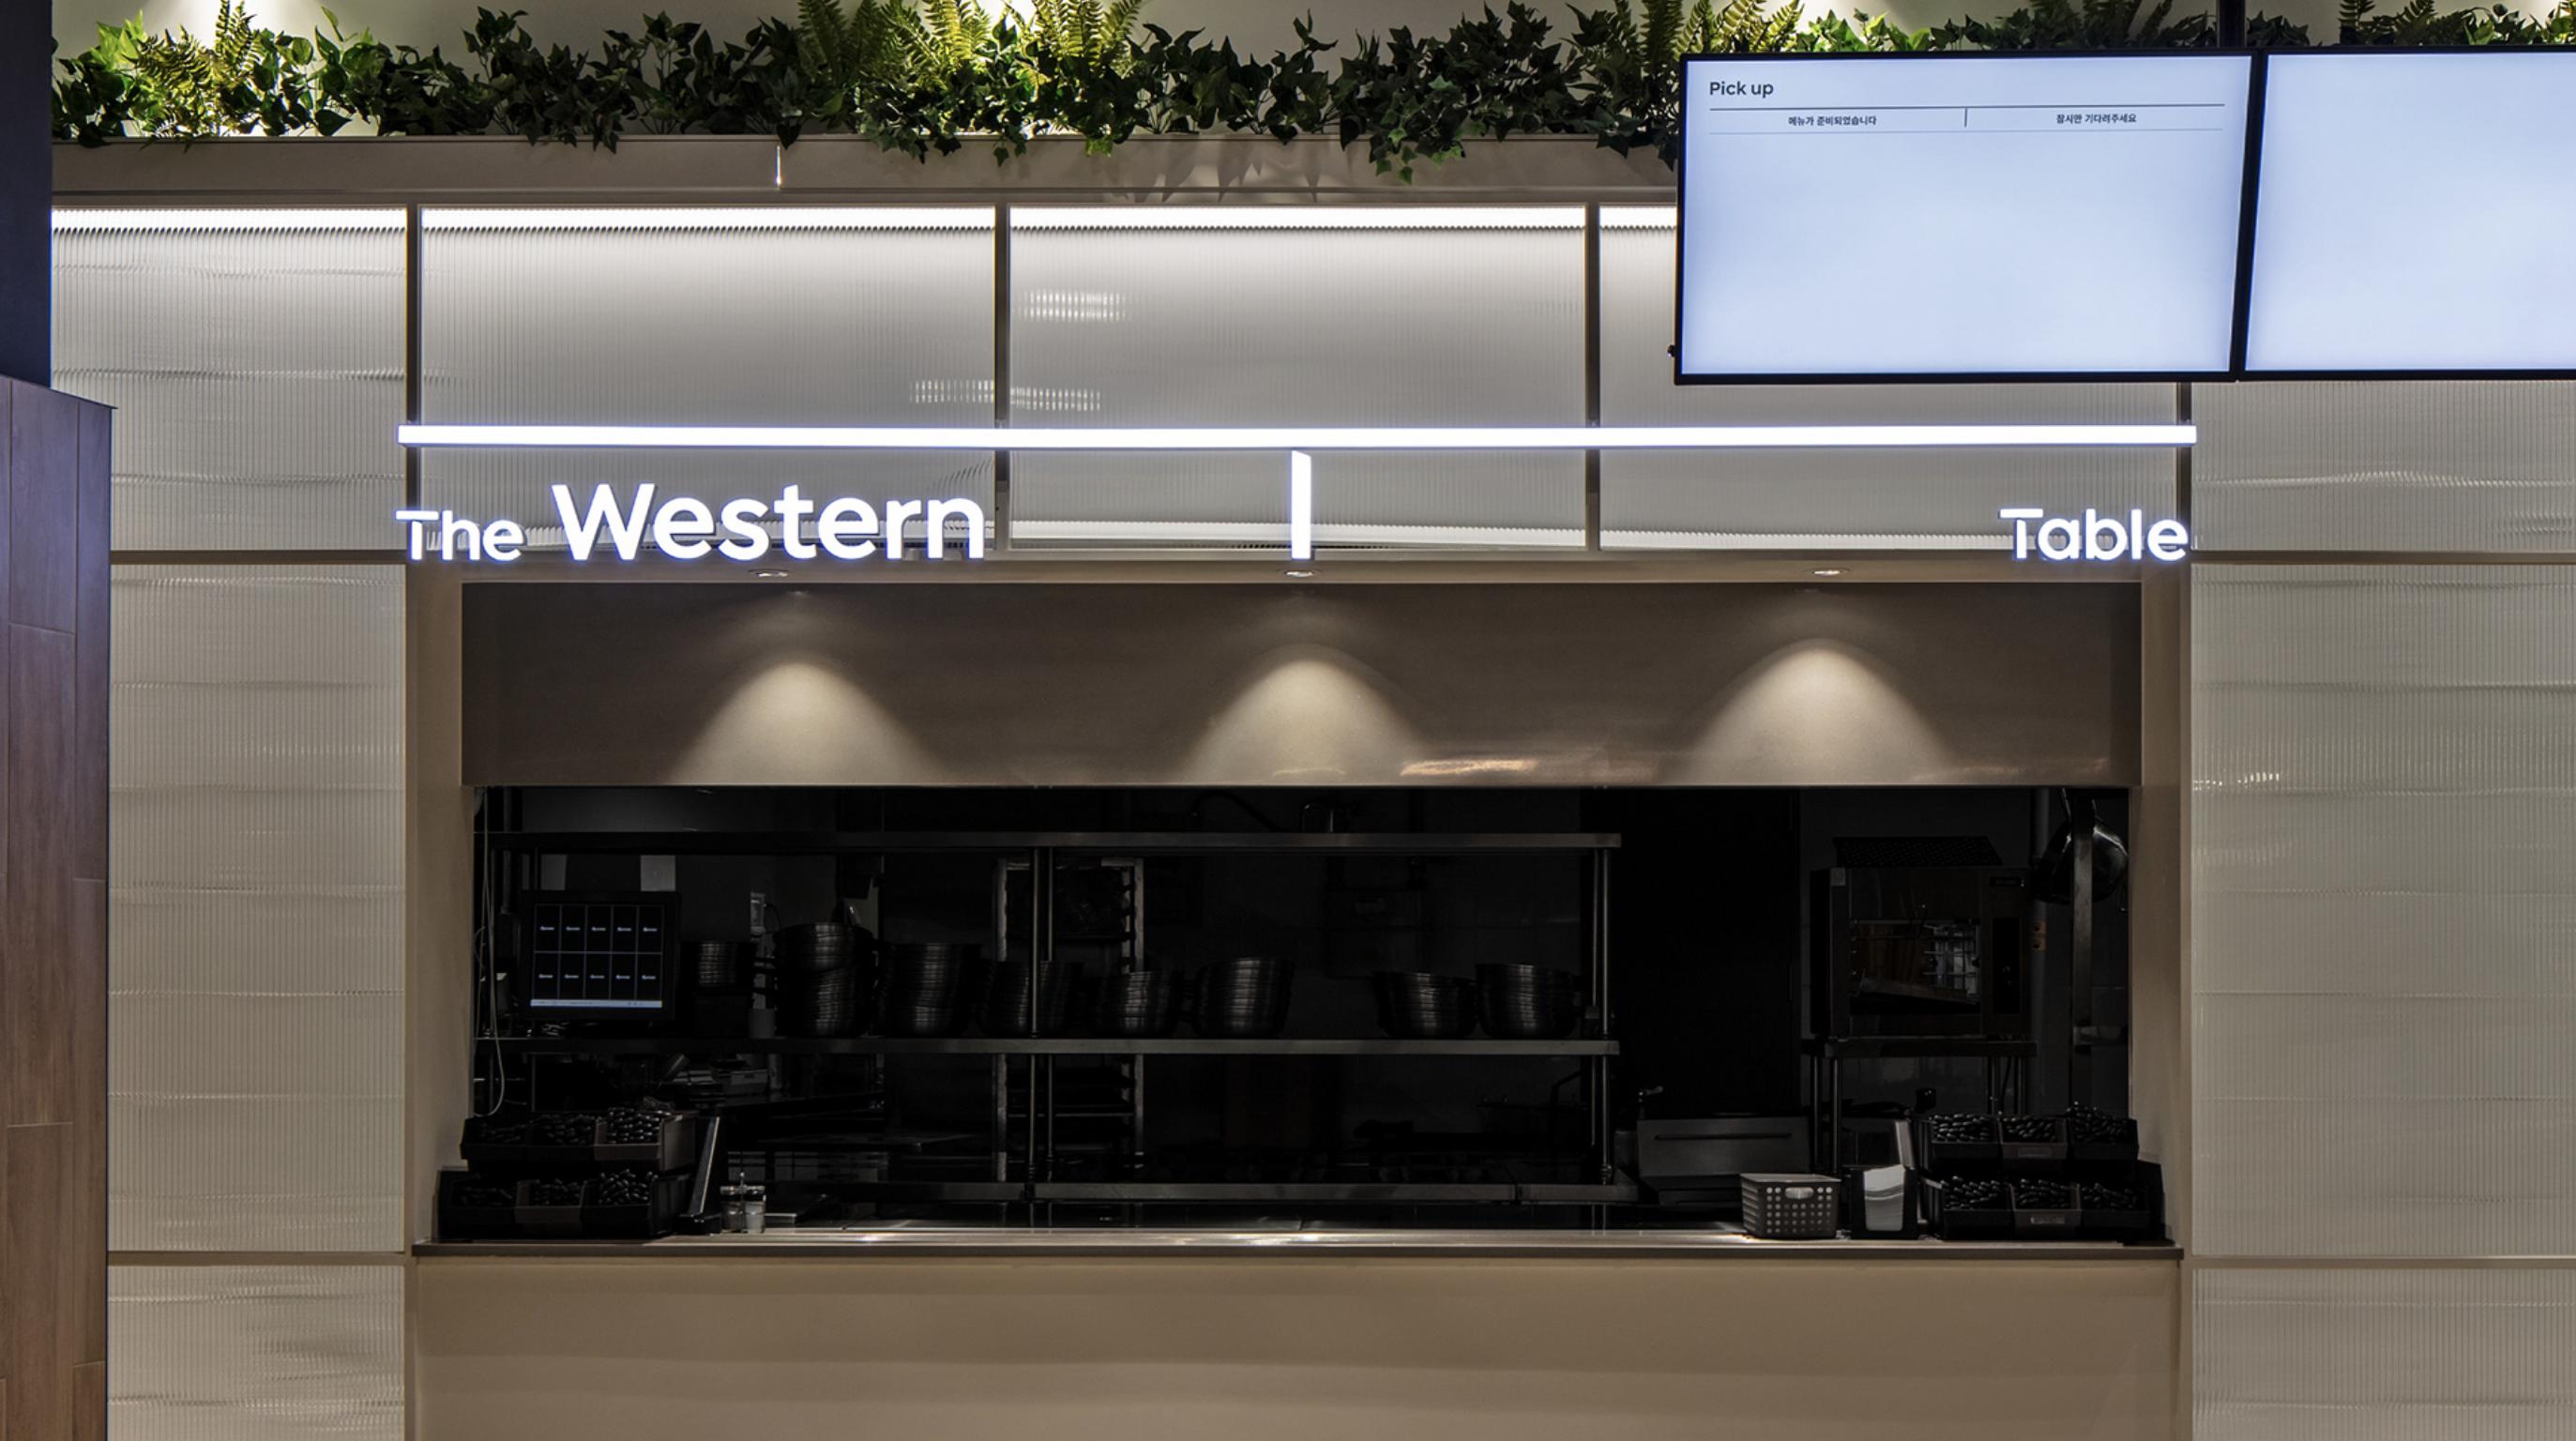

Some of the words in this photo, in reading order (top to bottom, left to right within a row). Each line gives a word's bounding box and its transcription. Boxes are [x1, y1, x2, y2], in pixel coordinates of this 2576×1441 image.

[1710, 81, 1746, 96] Pick
[1751, 83, 1774, 99] up
[1788, 115, 1814, 127] 메뉴가
[1817, 115, 1877, 127] 준비되었습니다
[2056, 114, 2083, 124] 잠시만
[2084, 114, 2137, 124] 기다려주세요
[396, 509, 523, 561] The
[551, 482, 985, 561] Western
[1999, 508, 2190, 562] Table
